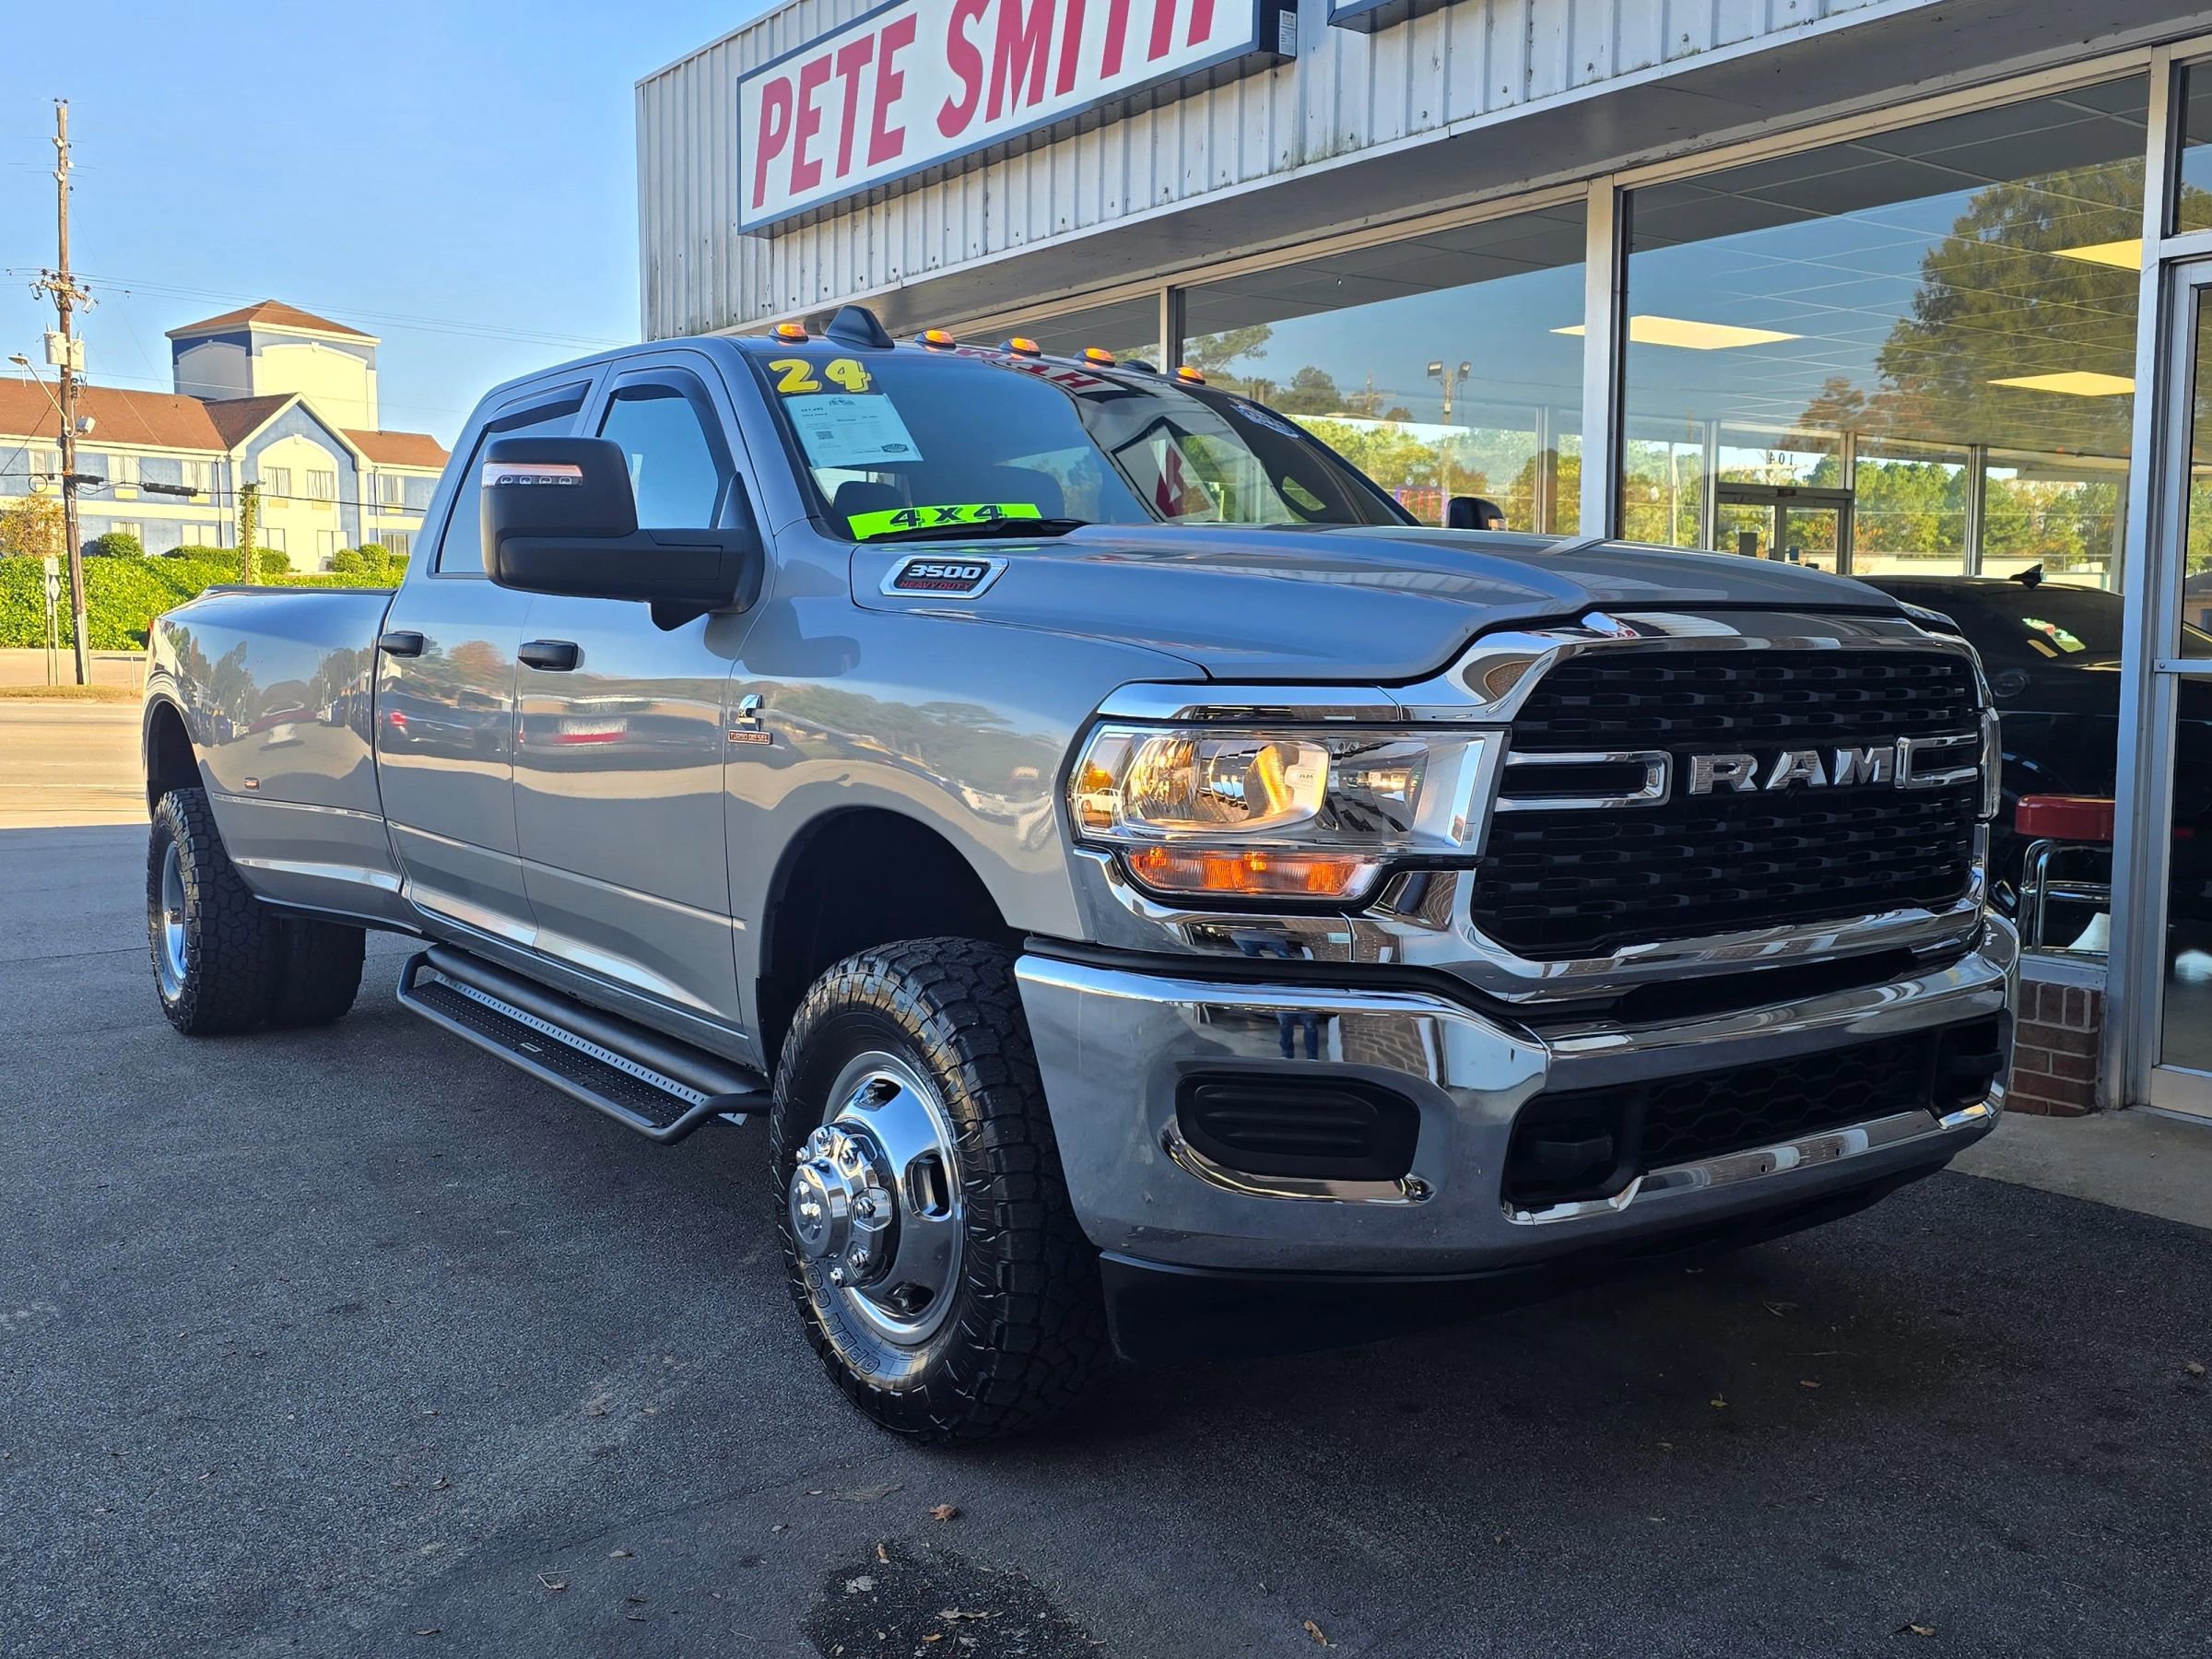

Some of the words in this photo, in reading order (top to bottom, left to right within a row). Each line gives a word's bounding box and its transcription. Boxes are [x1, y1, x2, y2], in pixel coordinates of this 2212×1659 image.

[752, 12, 917, 210] PETE
[769, 359, 872, 393] 24
[908, 564, 982, 579] 3500
[1688, 747, 1893, 794] RAM
